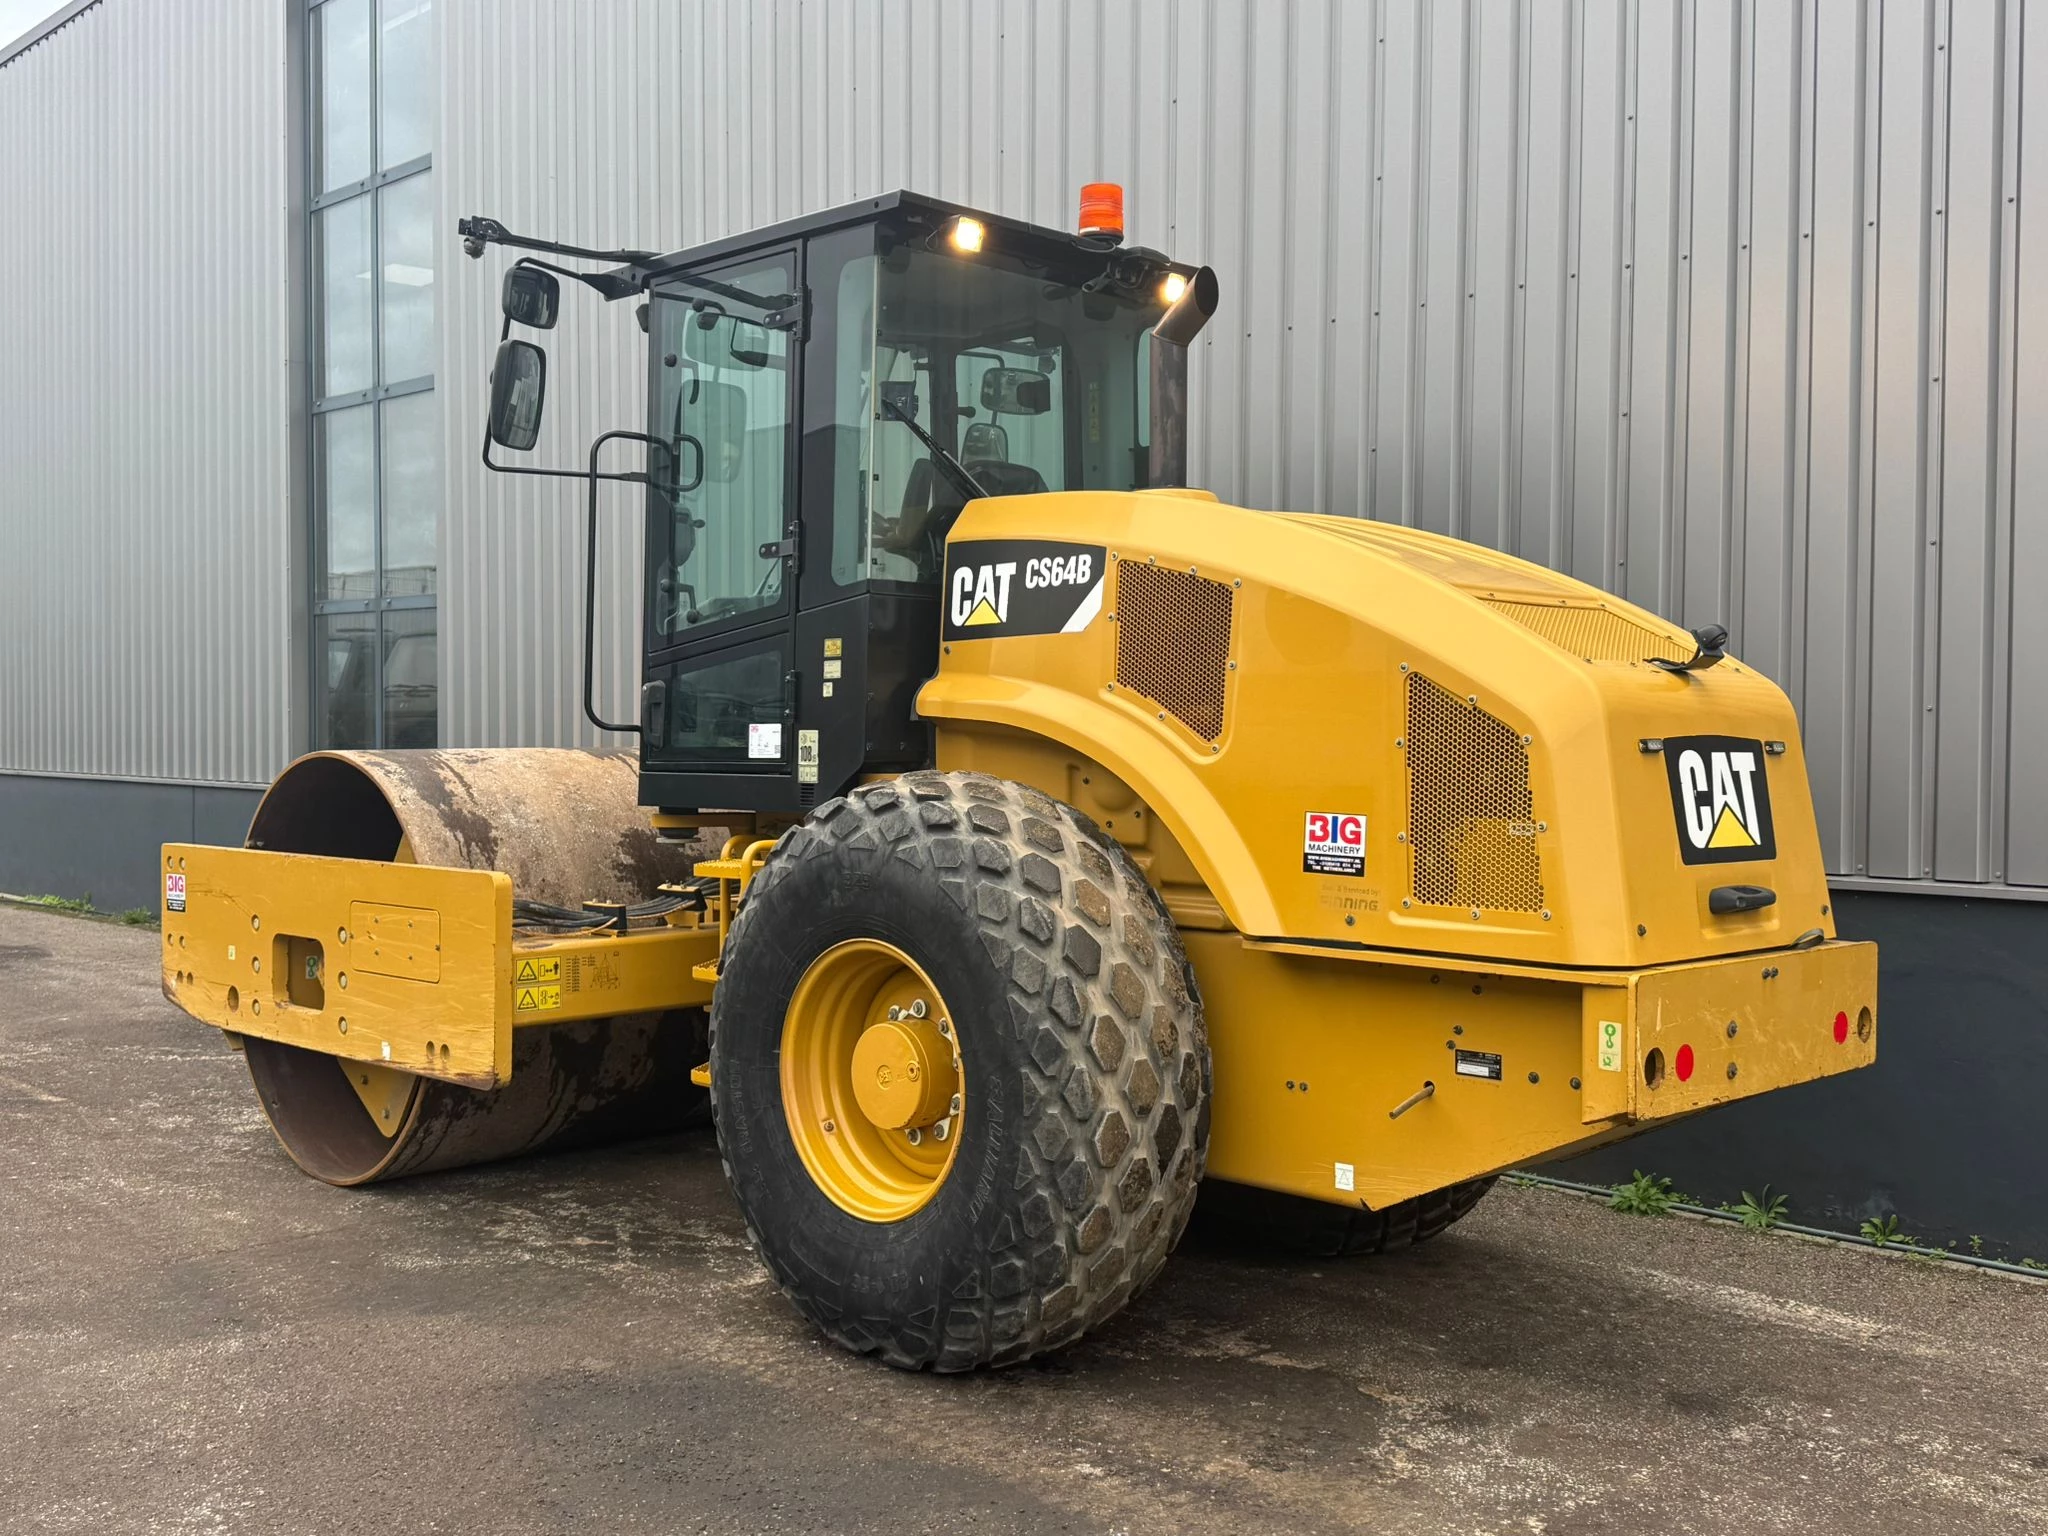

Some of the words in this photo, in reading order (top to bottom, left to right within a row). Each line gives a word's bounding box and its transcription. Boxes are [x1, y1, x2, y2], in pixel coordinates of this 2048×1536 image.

[951, 562, 1017, 627] CAT
[1025, 553, 1092, 589] CS64B
[800, 745, 812, 762] 108
[1678, 749, 1762, 849] CAT
[1309, 814, 1361, 845] BIG
[1308, 843, 1361, 855] MACHINERY
[168, 875, 184, 893] BIG
